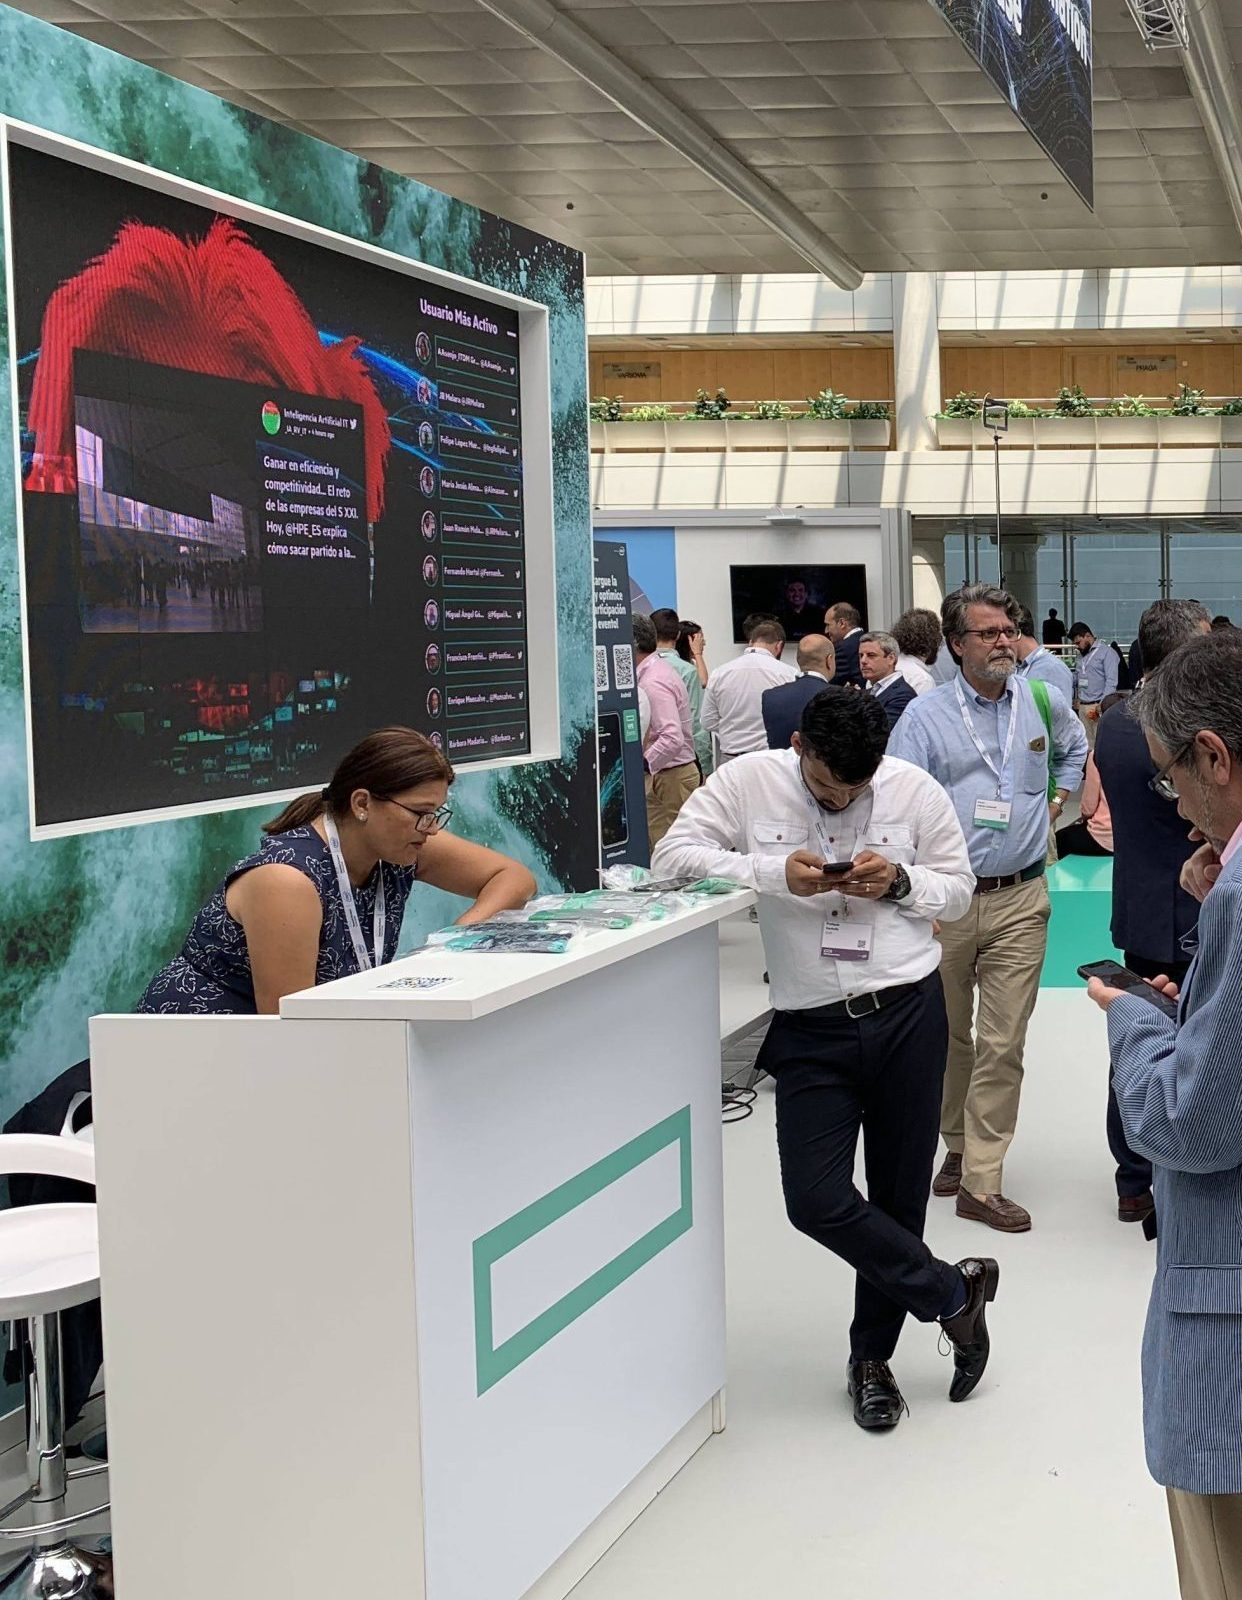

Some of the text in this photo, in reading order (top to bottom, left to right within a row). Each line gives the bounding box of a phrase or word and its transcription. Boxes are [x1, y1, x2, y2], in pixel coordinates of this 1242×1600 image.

[420, 298, 498, 334] Usuario Más Activo
[284, 408, 348, 428] Inteligencia Artificial IT
[263, 456, 340, 480] Ganar en eficiencia y
[328, 484, 335, 497] El
[336, 487, 351, 498] reto
[266, 498, 359, 519] de las empresas del S XXI.
[266, 520, 348, 540] Hoy, @HPE_ES explica
[267, 542, 289, 555] cómo
[290, 546, 309, 556] sacar
[310, 545, 338, 559] partido
[611, 575, 617, 587] la
[599, 588, 623, 603] optimice
[594, 604, 626, 616] articipación
